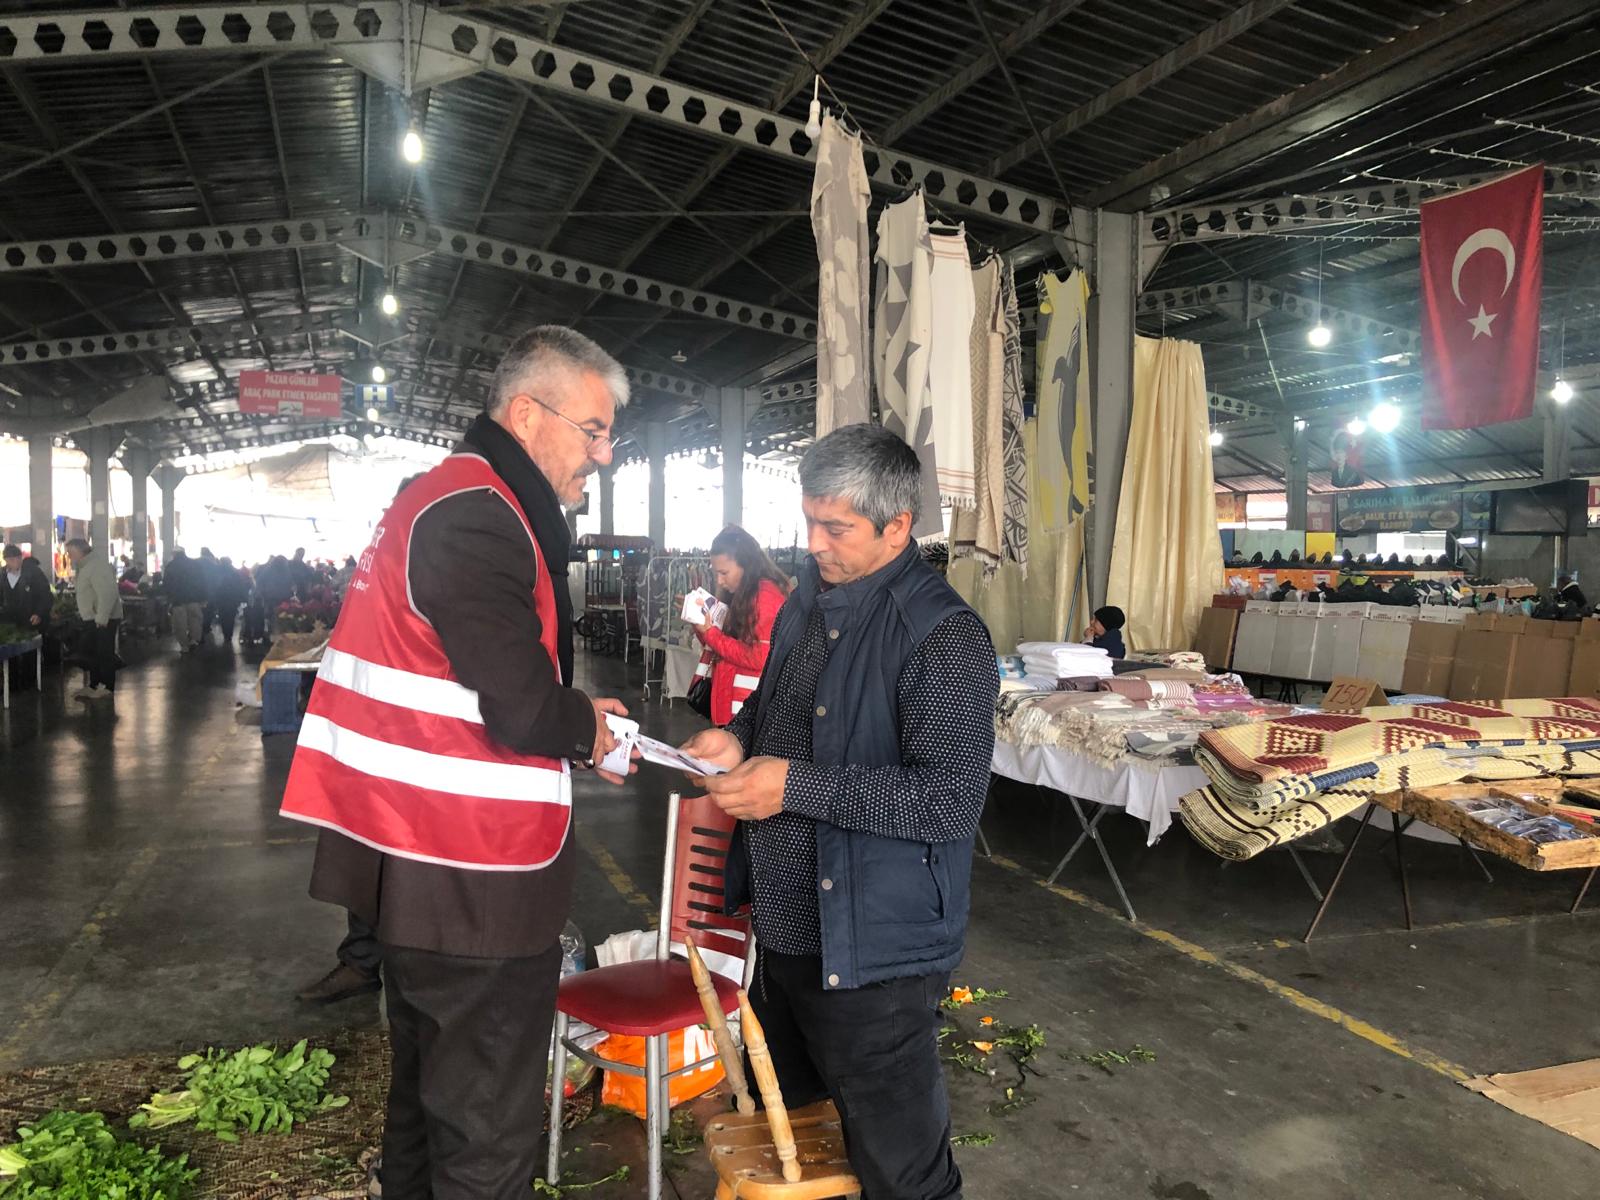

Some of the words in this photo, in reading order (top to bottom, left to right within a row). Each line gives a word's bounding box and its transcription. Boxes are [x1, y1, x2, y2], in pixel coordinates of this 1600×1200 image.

[265, 374, 288, 385] PAZAR
[262, 387, 281, 399] PARK
[363, 386, 387, 401] H
